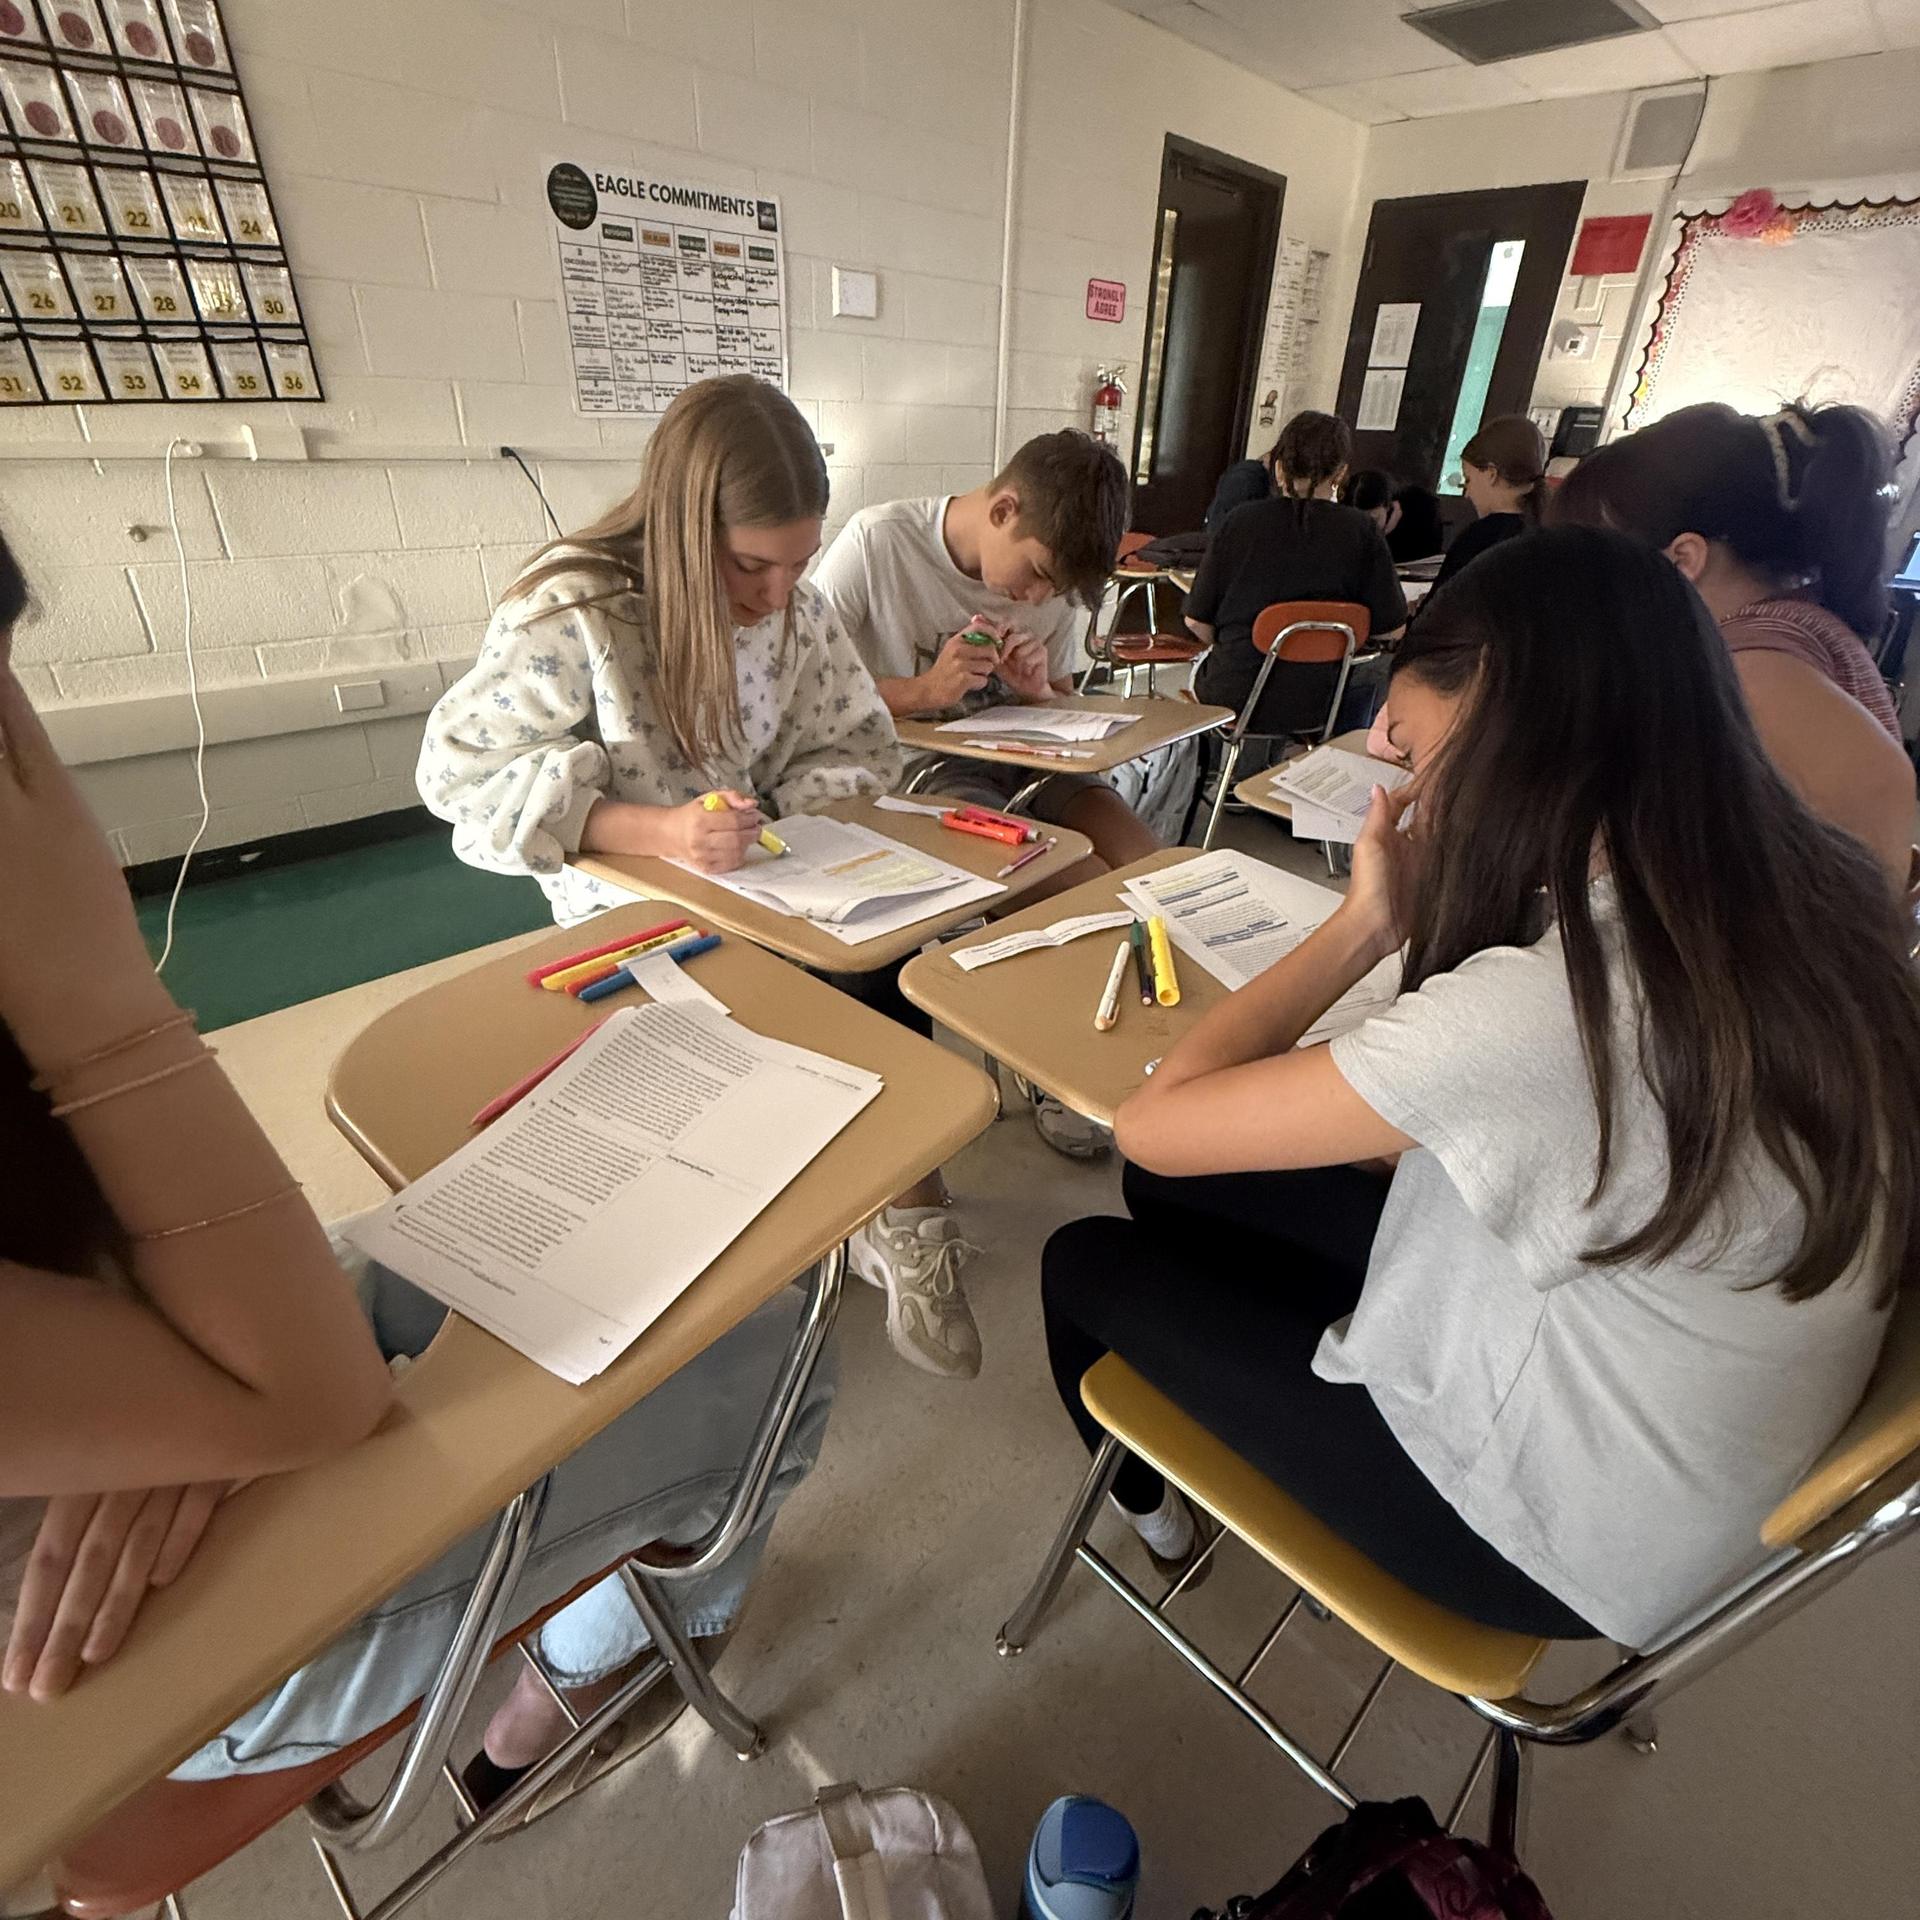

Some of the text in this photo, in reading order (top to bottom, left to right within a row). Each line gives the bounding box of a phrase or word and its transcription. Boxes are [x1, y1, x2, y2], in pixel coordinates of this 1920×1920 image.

[595, 173, 646, 200] EAGLE
[648, 183, 755, 217] COMMITMENTS
[62, 206, 85, 224] 21
[126, 211, 150, 228] 22
[240, 220, 262, 235] 24
[1089, 284, 1123, 302] STRONGLY
[29, 293, 56, 310] 26
[94, 295, 117, 312] 27
[153, 296, 177, 312] 28
[264, 300, 285, 314] 30
[1094, 300, 1118, 317] AGREE
[0, 375, 303, 392] 31 32 33 34 35 36
